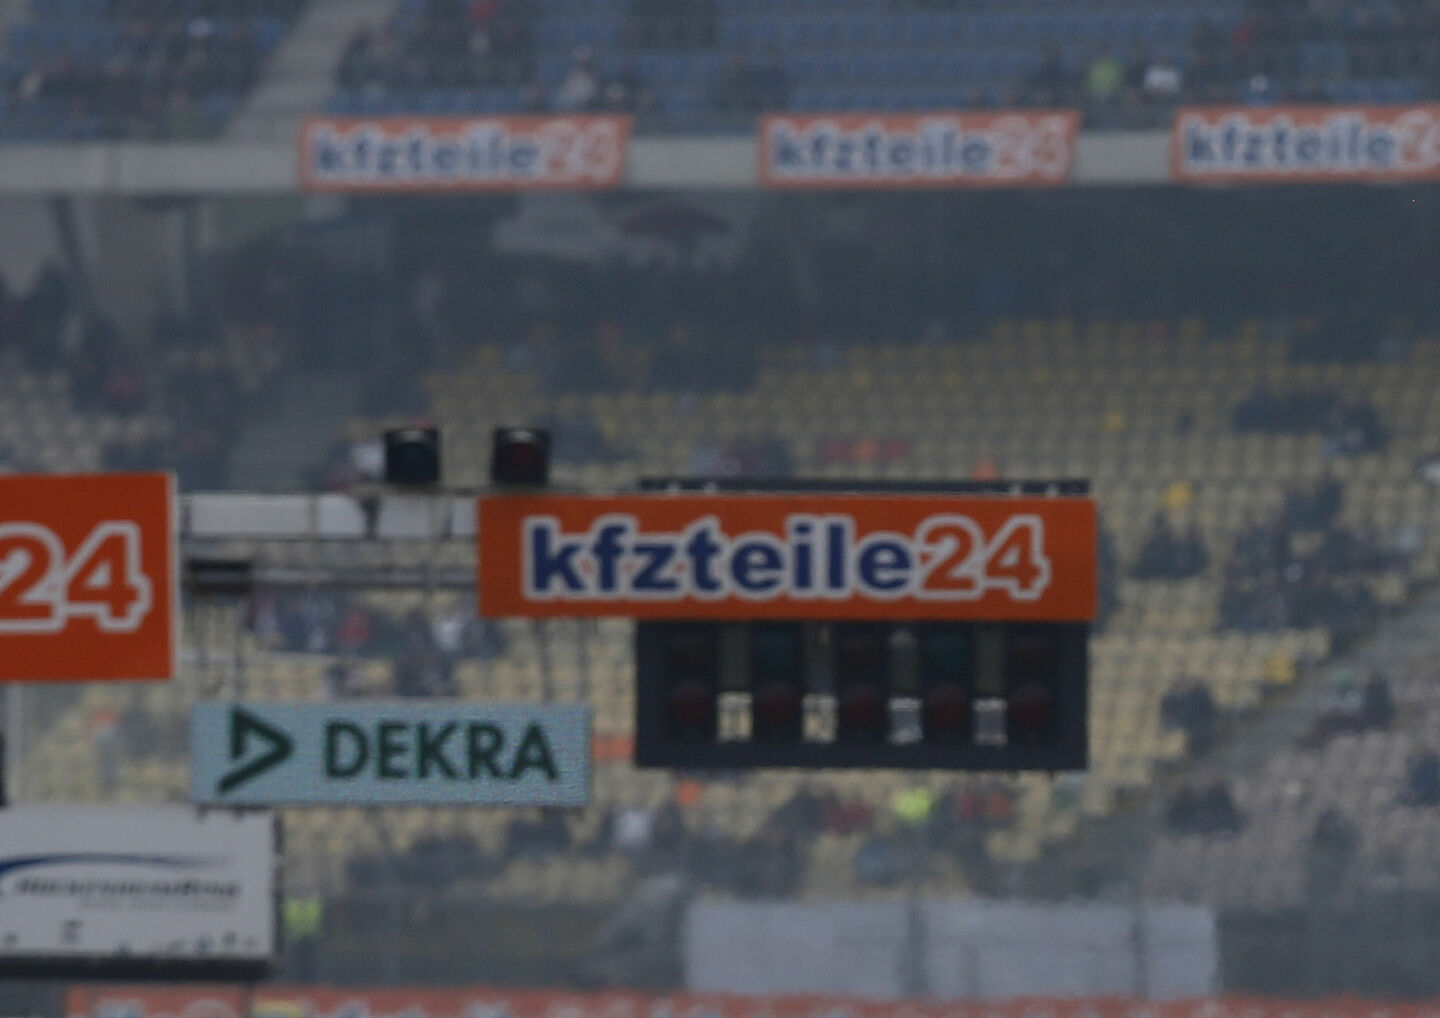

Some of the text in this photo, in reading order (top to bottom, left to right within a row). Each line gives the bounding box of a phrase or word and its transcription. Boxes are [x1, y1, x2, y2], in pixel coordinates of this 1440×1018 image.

[309, 122, 620, 185] kfzteile24
[768, 116, 1070, 180] kfzteile24
[523, 514, 1051, 600] kfzteile24
[324, 718, 559, 781] DEKRA
